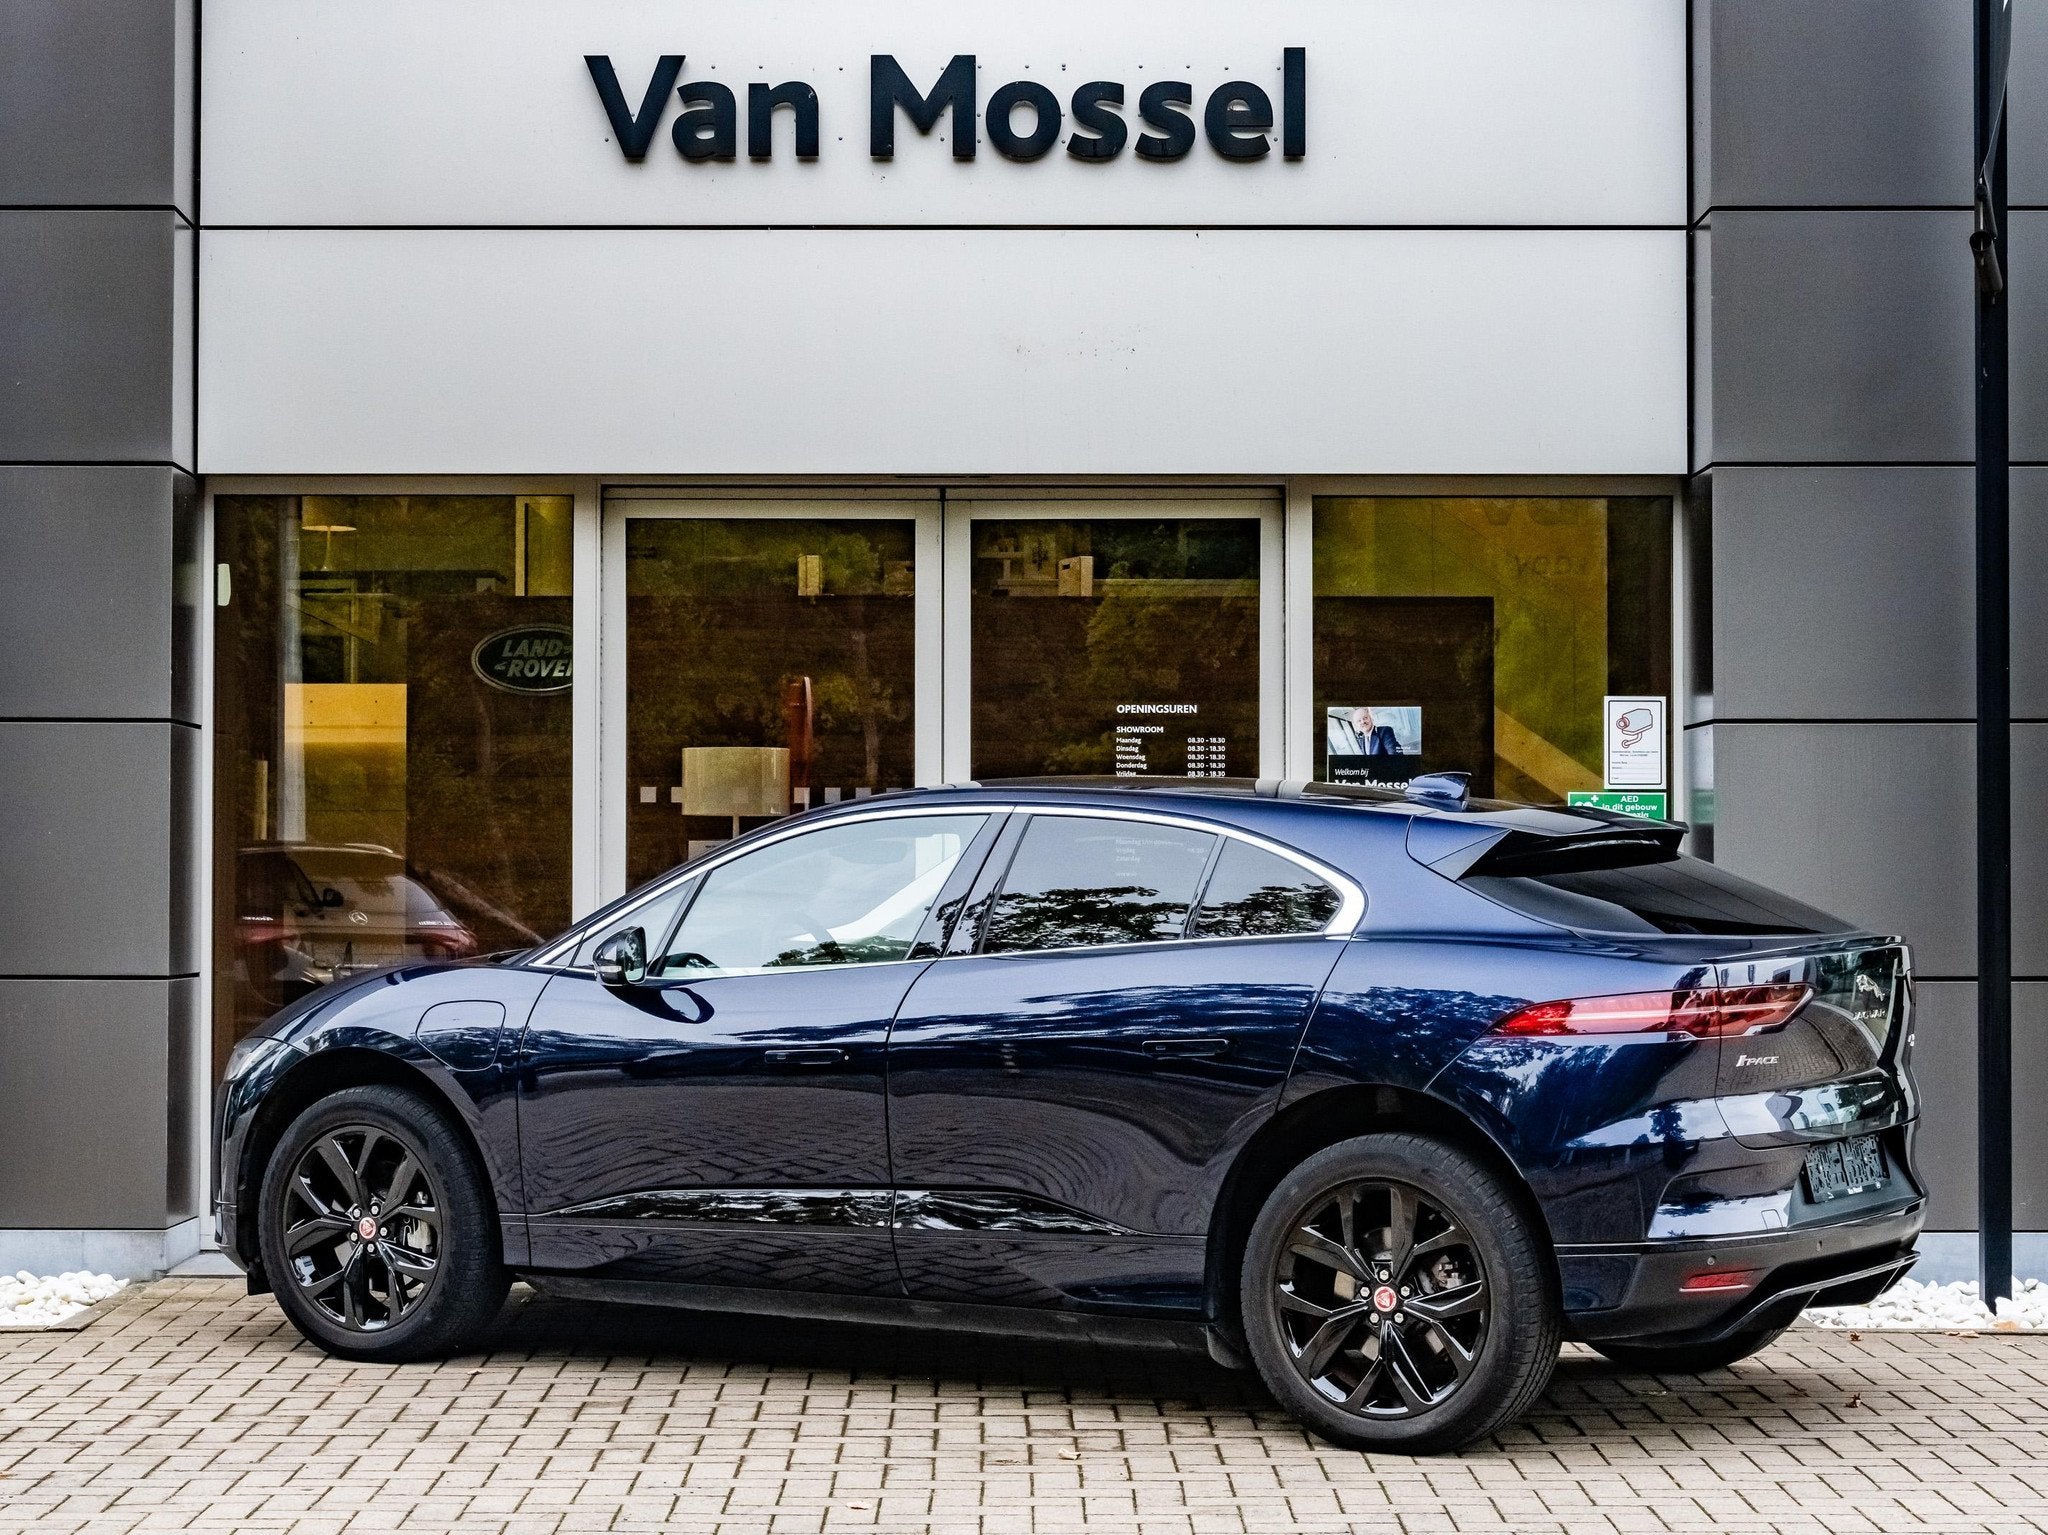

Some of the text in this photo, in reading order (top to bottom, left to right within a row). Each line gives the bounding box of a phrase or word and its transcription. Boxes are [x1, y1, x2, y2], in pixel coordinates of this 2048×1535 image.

[583, 47, 1306, 160] Van Mossel
[501, 639, 563, 657] LAND
[1116, 704, 1198, 714] OPENINGSUREN
[1116, 762, 1148, 770] Donderdag
[1360, 767, 1369, 777] bij
[1612, 803, 1624, 811] dit
[1625, 803, 1658, 811] gebouw
